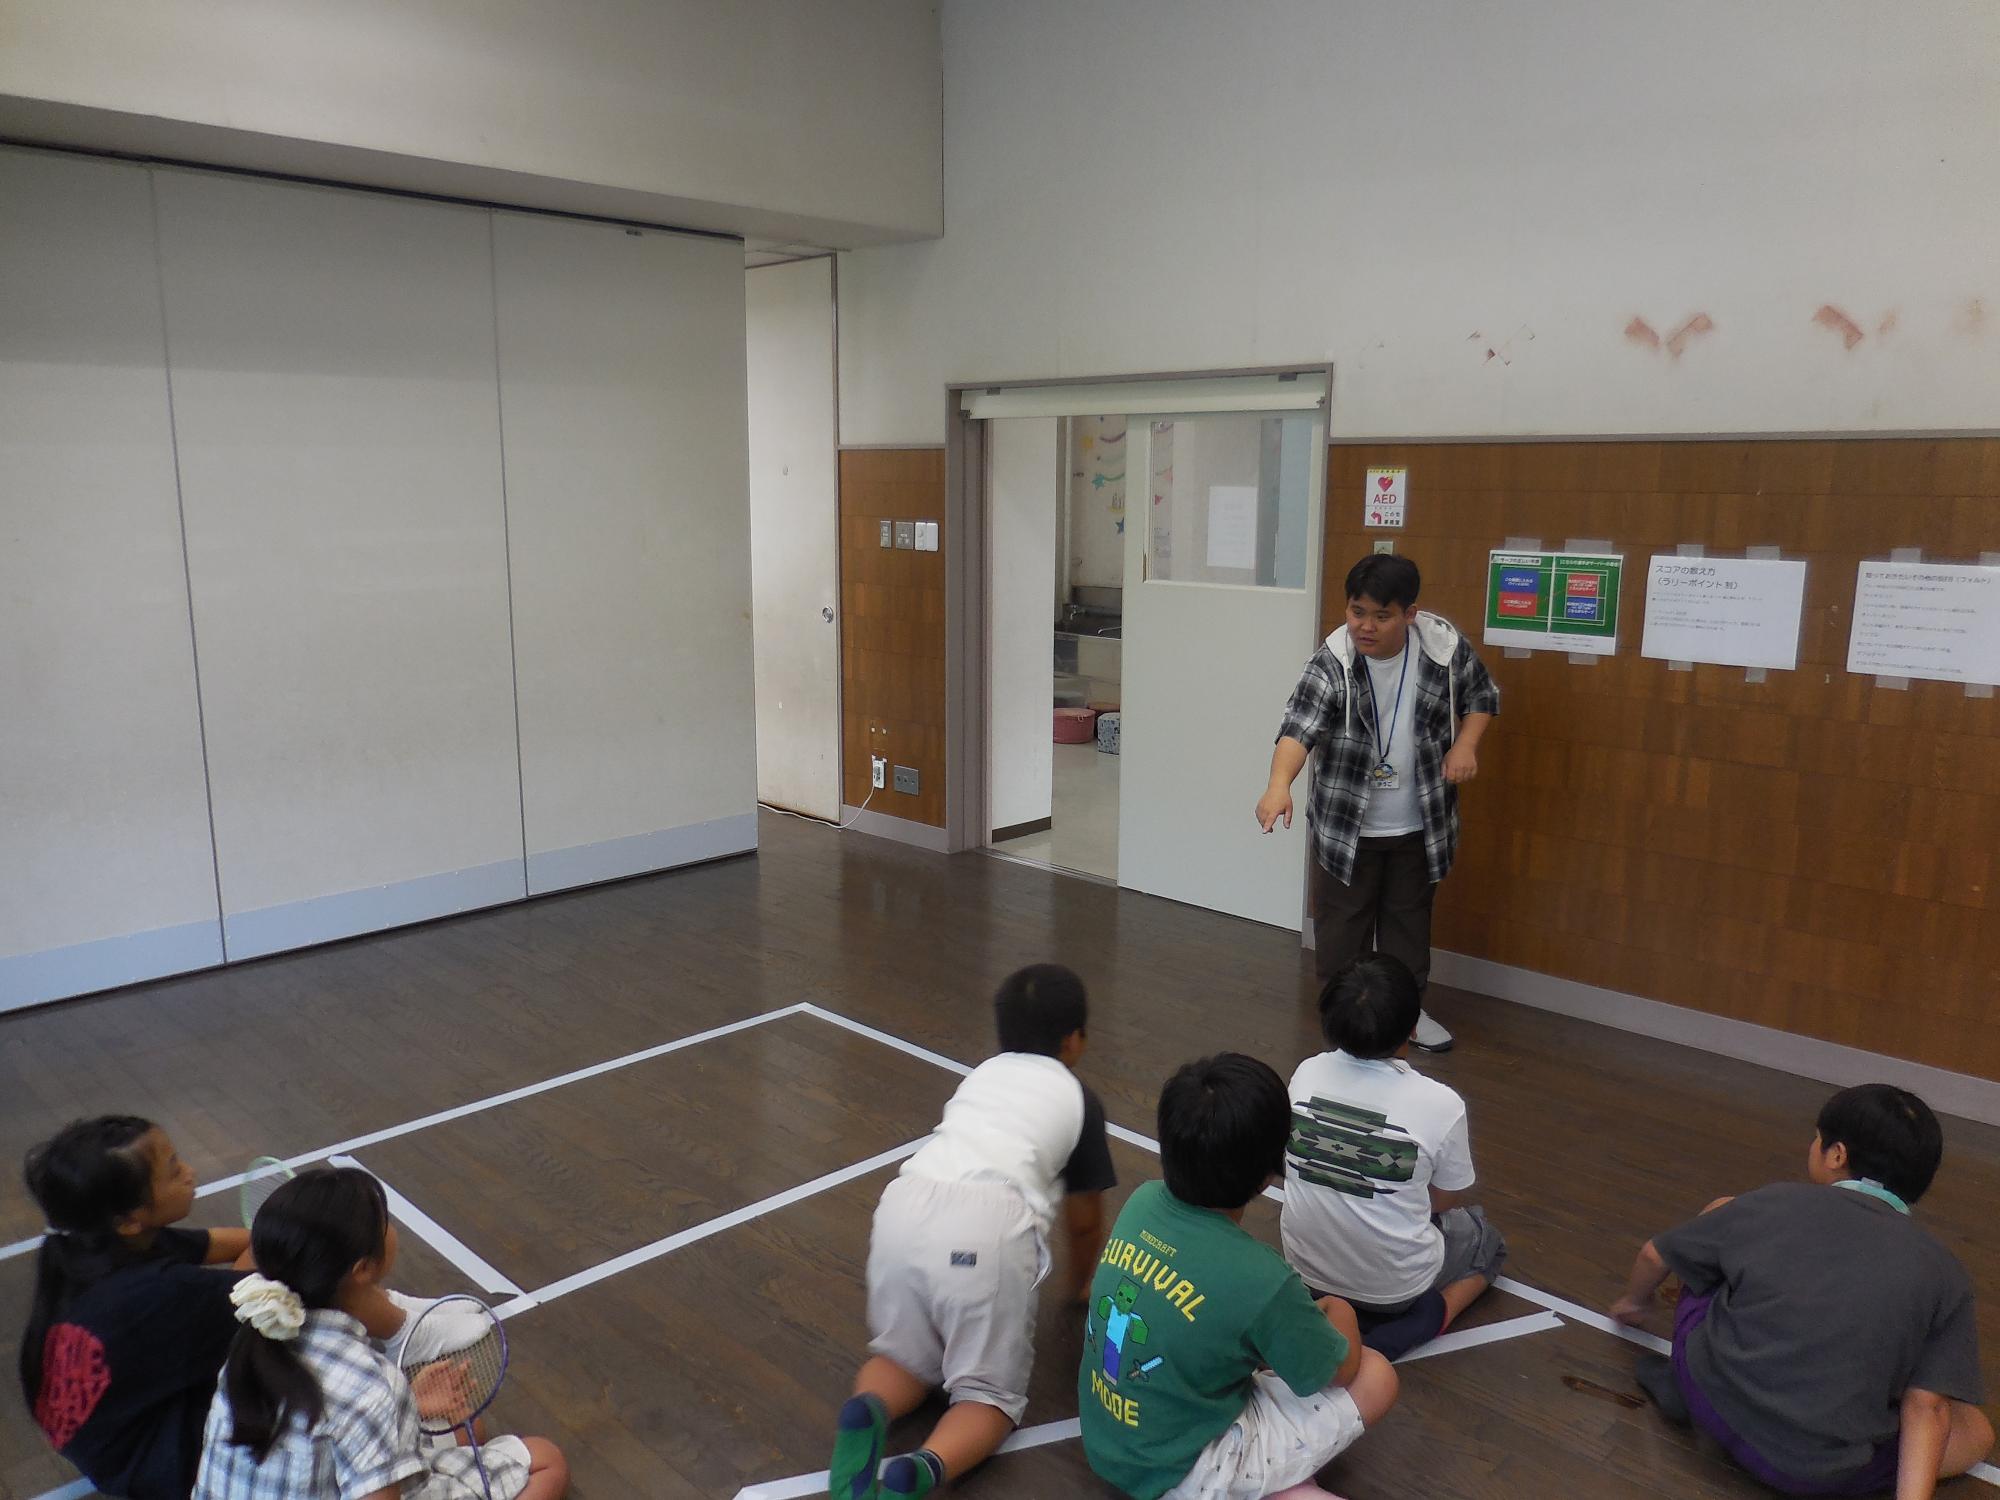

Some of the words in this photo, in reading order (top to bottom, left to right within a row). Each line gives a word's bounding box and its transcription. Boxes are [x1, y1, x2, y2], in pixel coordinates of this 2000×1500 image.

[1373, 494, 1397, 504] AED
[1655, 565, 1716, 576] スコアの数え方
[1101, 1238, 1206, 1323] SURVIVAL
[1091, 1368, 1140, 1428] MODE
